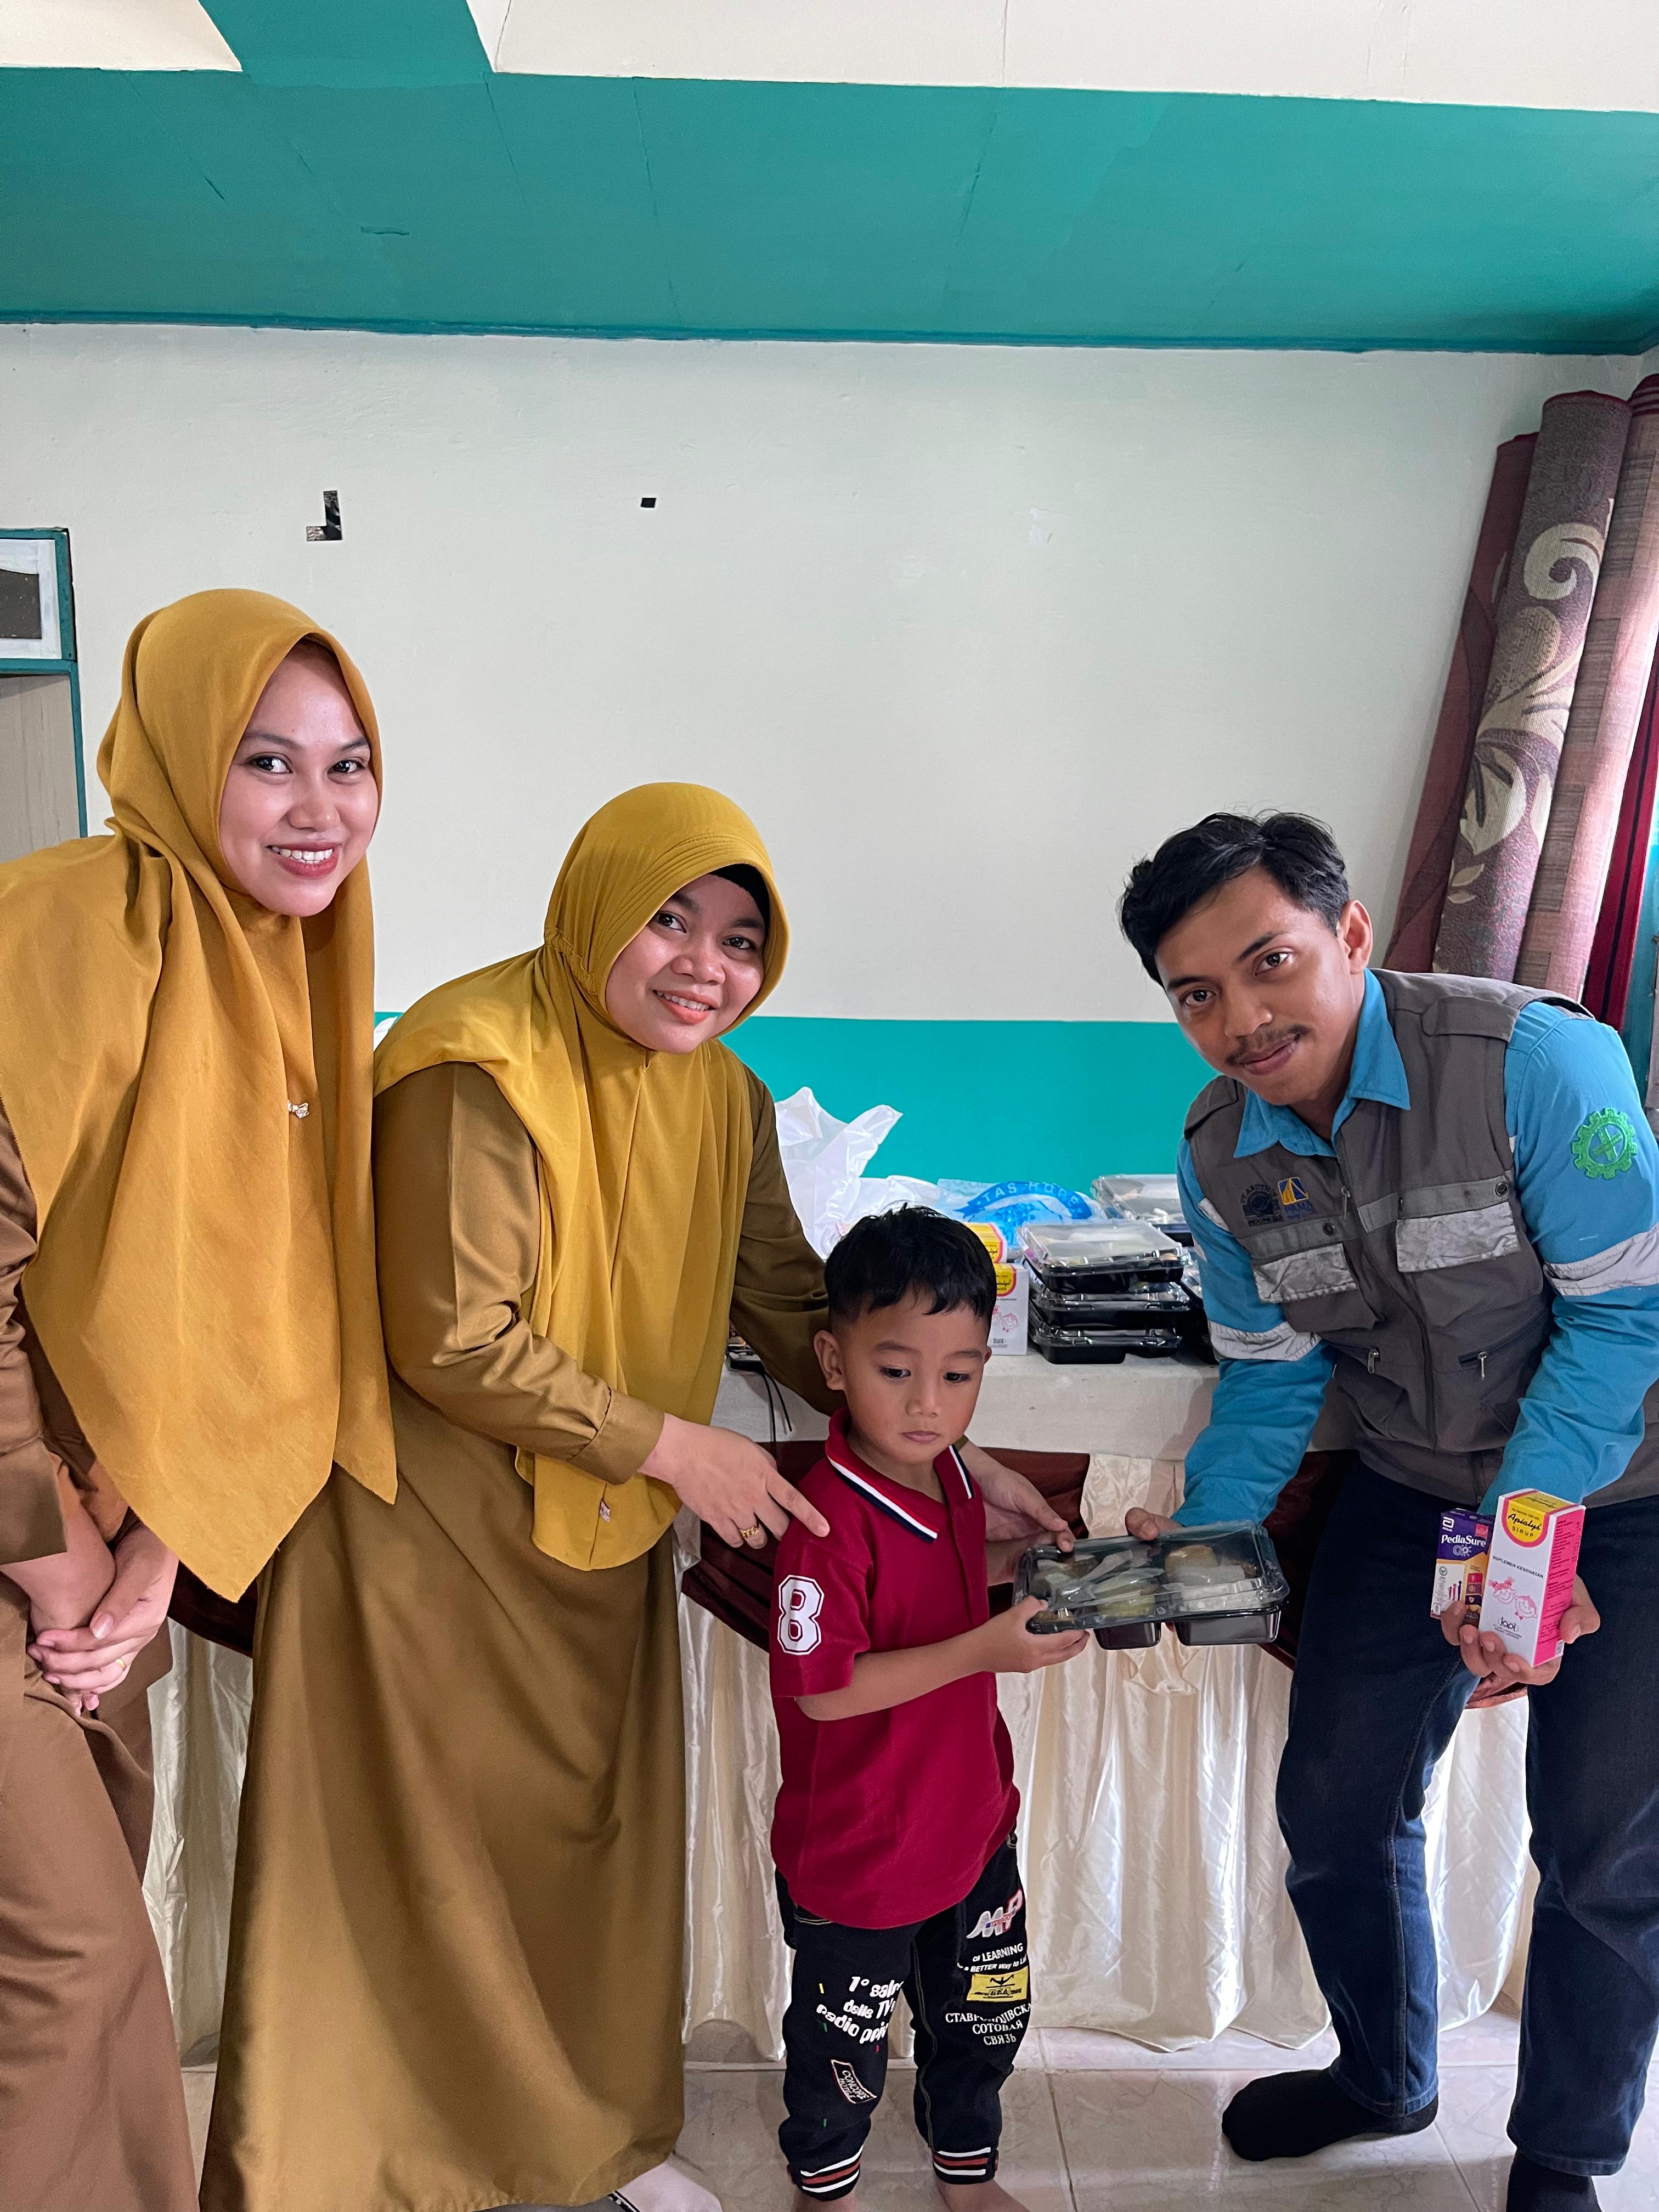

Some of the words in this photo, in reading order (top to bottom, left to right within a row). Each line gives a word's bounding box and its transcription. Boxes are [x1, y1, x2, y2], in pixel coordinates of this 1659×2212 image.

[981, 1182, 1017, 1202] TAS
[1512, 1525, 1534, 1537] SIRUP
[1441, 1534, 1486, 1548] PediaSure
[1516, 1565, 1544, 1578] KESEHATAN
[777, 1575, 825, 1656] 8
[981, 1943, 1024, 1962] LEARNING
[970, 1963, 998, 1972] BETTER
[843, 1999, 874, 2019] delle
[816, 2004, 860, 2037] radio
[983, 2033, 1017, 2045] СВЯЗЬ
